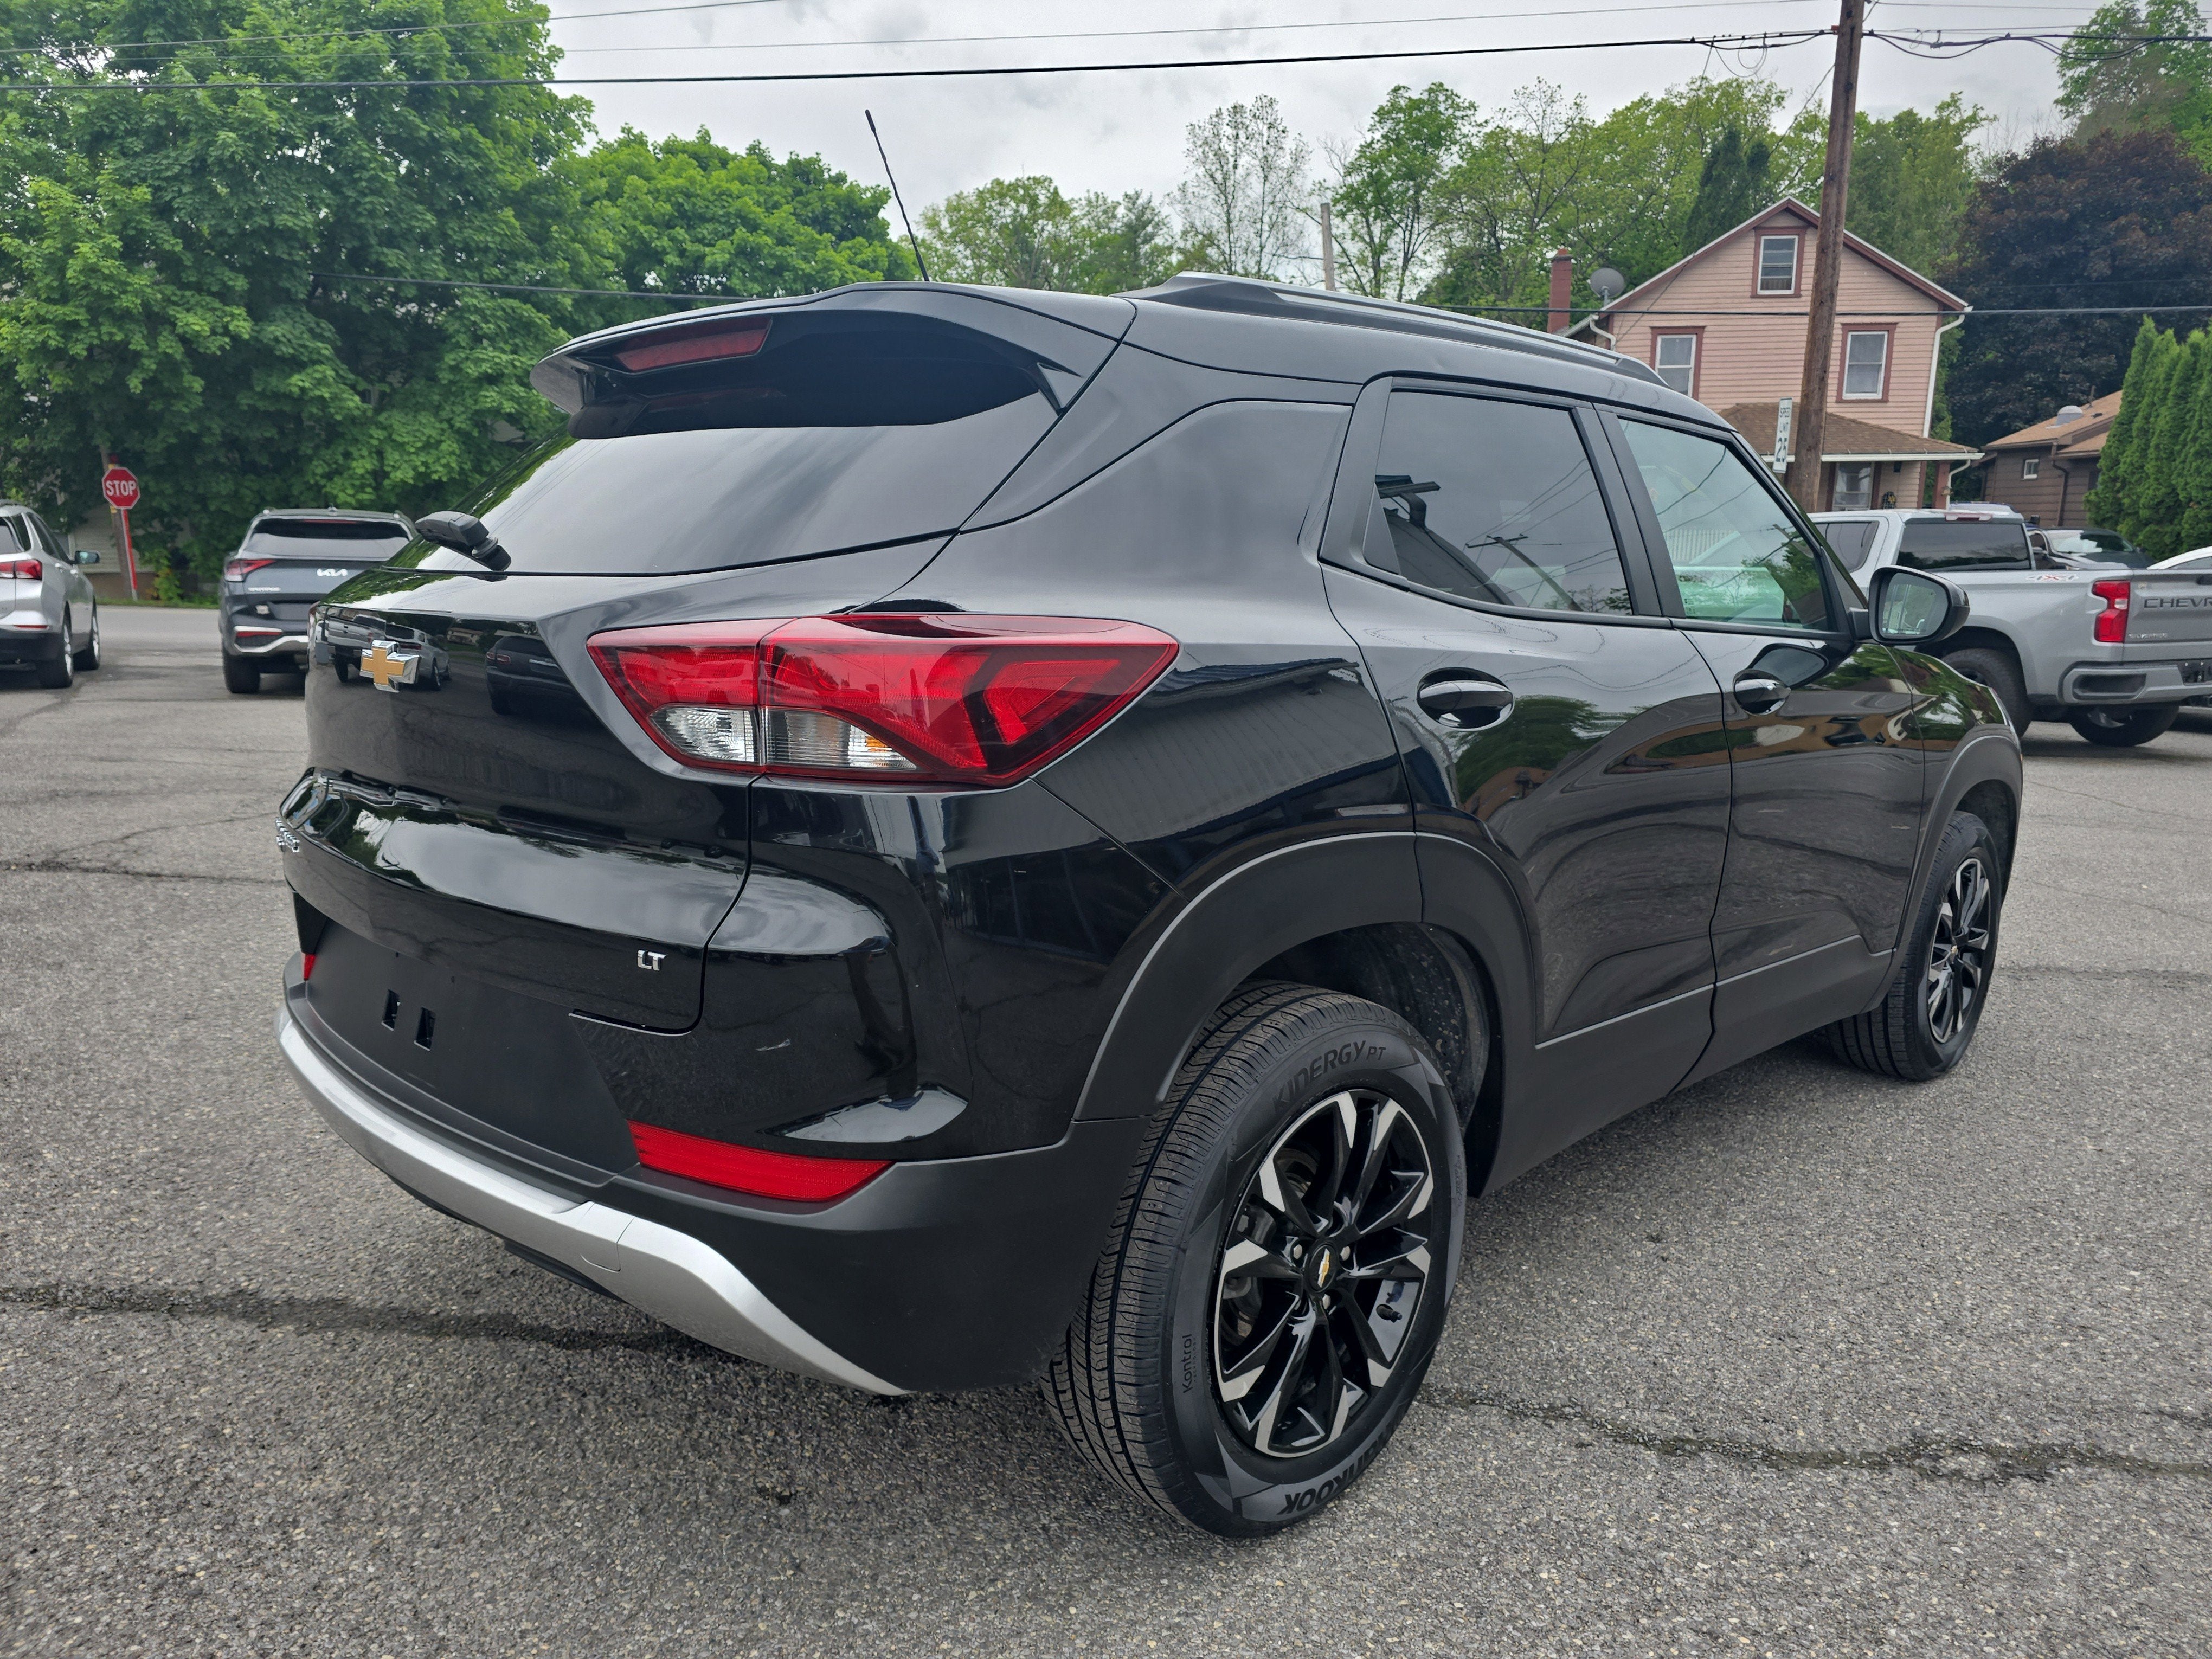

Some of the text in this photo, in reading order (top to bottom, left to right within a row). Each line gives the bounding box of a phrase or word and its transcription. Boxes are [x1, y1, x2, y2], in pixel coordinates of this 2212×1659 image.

[1776, 437, 1787, 462] 25
[106, 480, 137, 496] STOP
[637, 949, 668, 971] LT
[1366, 1046, 1387, 1061] PT
[1181, 1334, 1193, 1394] Kontrol
